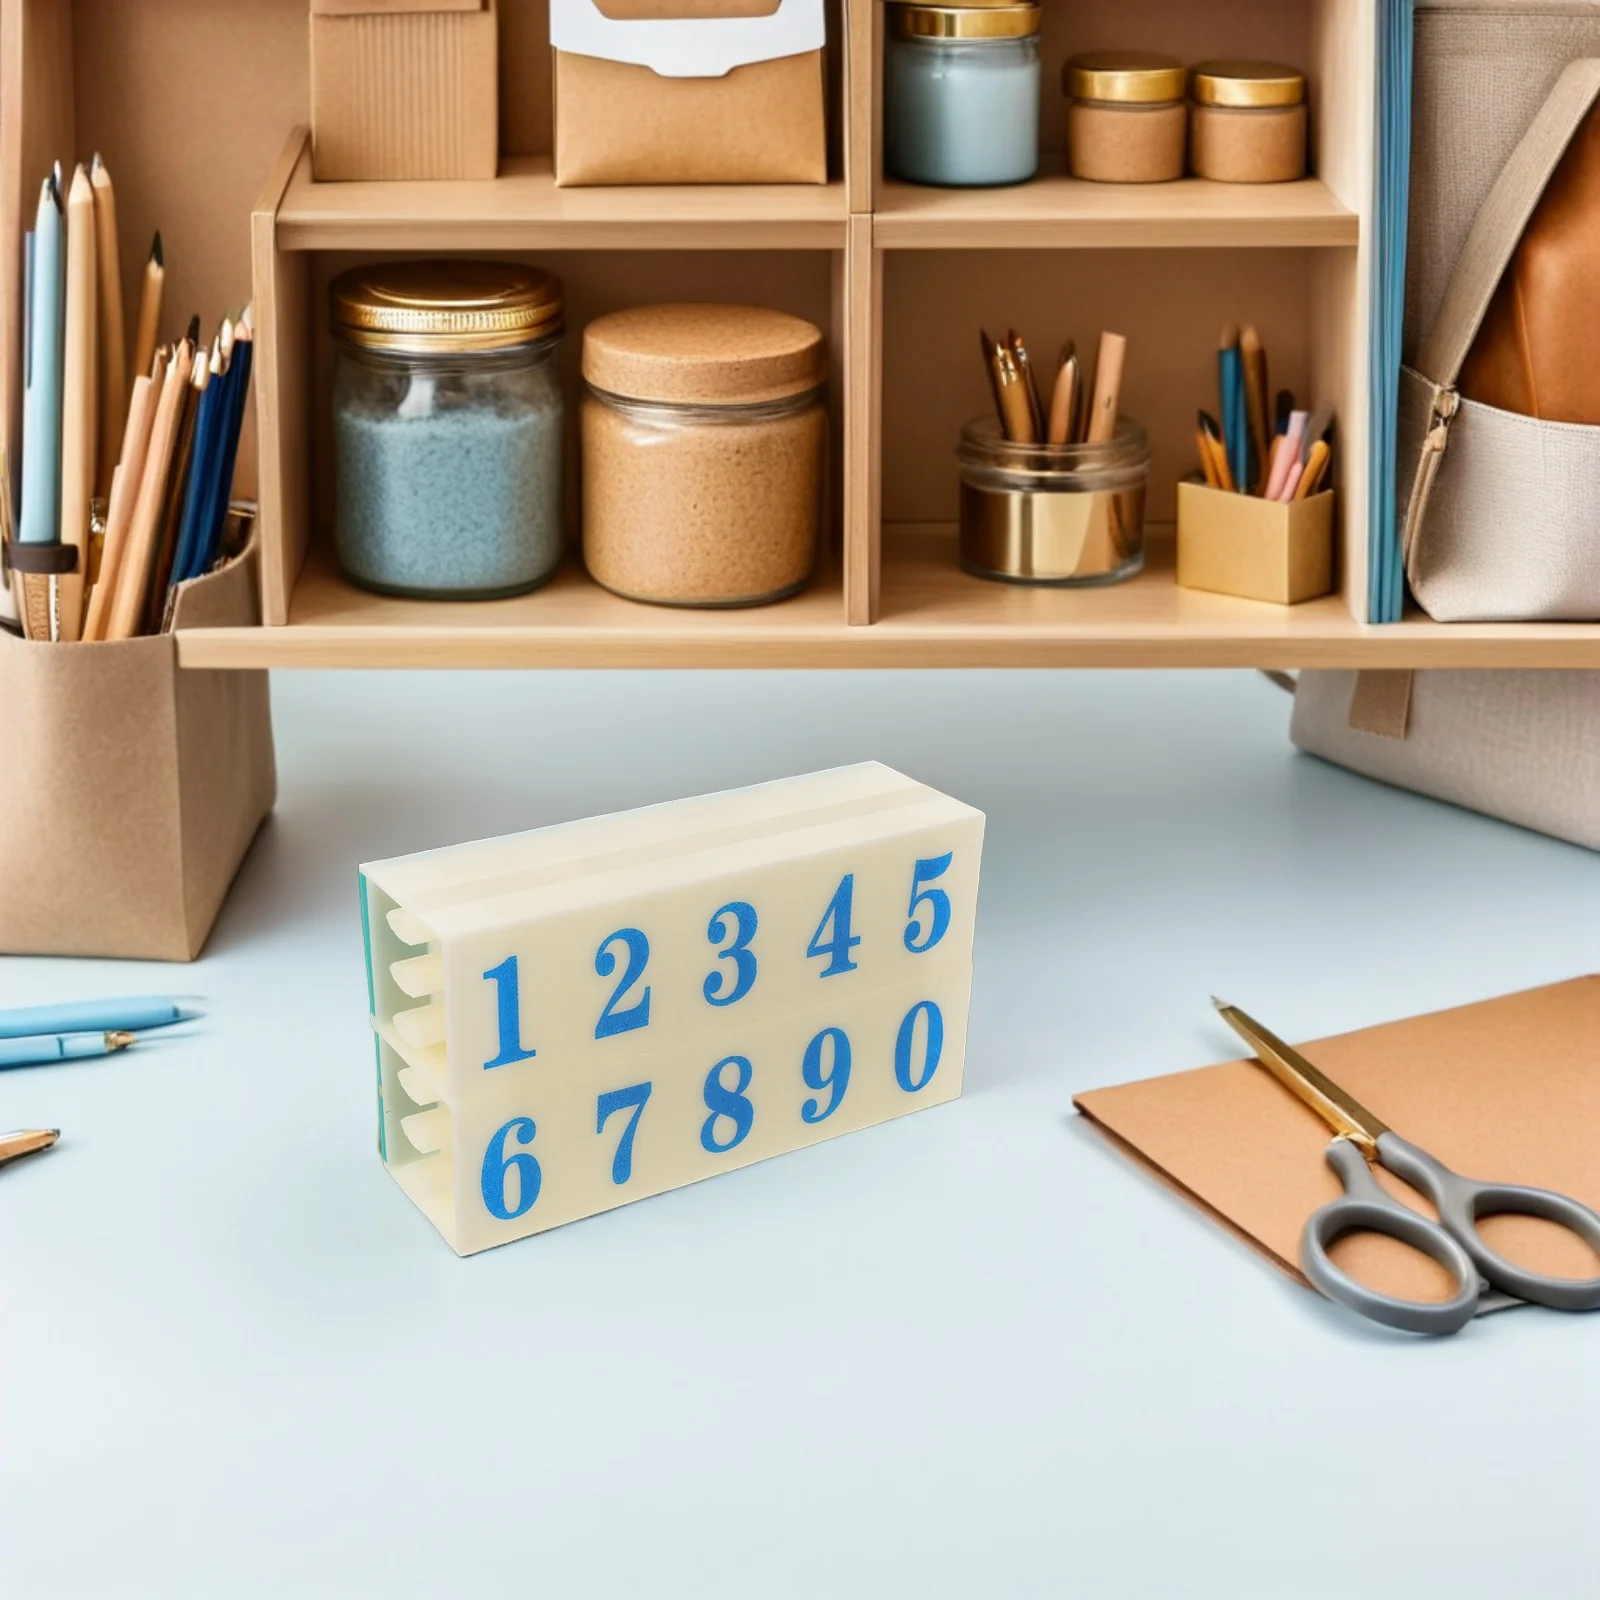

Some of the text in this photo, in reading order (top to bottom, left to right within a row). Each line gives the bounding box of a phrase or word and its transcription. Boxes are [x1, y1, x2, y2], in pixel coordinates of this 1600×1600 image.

[484, 852, 953, 1070] 1 2 3 4 5
[481, 1001, 944, 1220] 6 7 8 9 0
